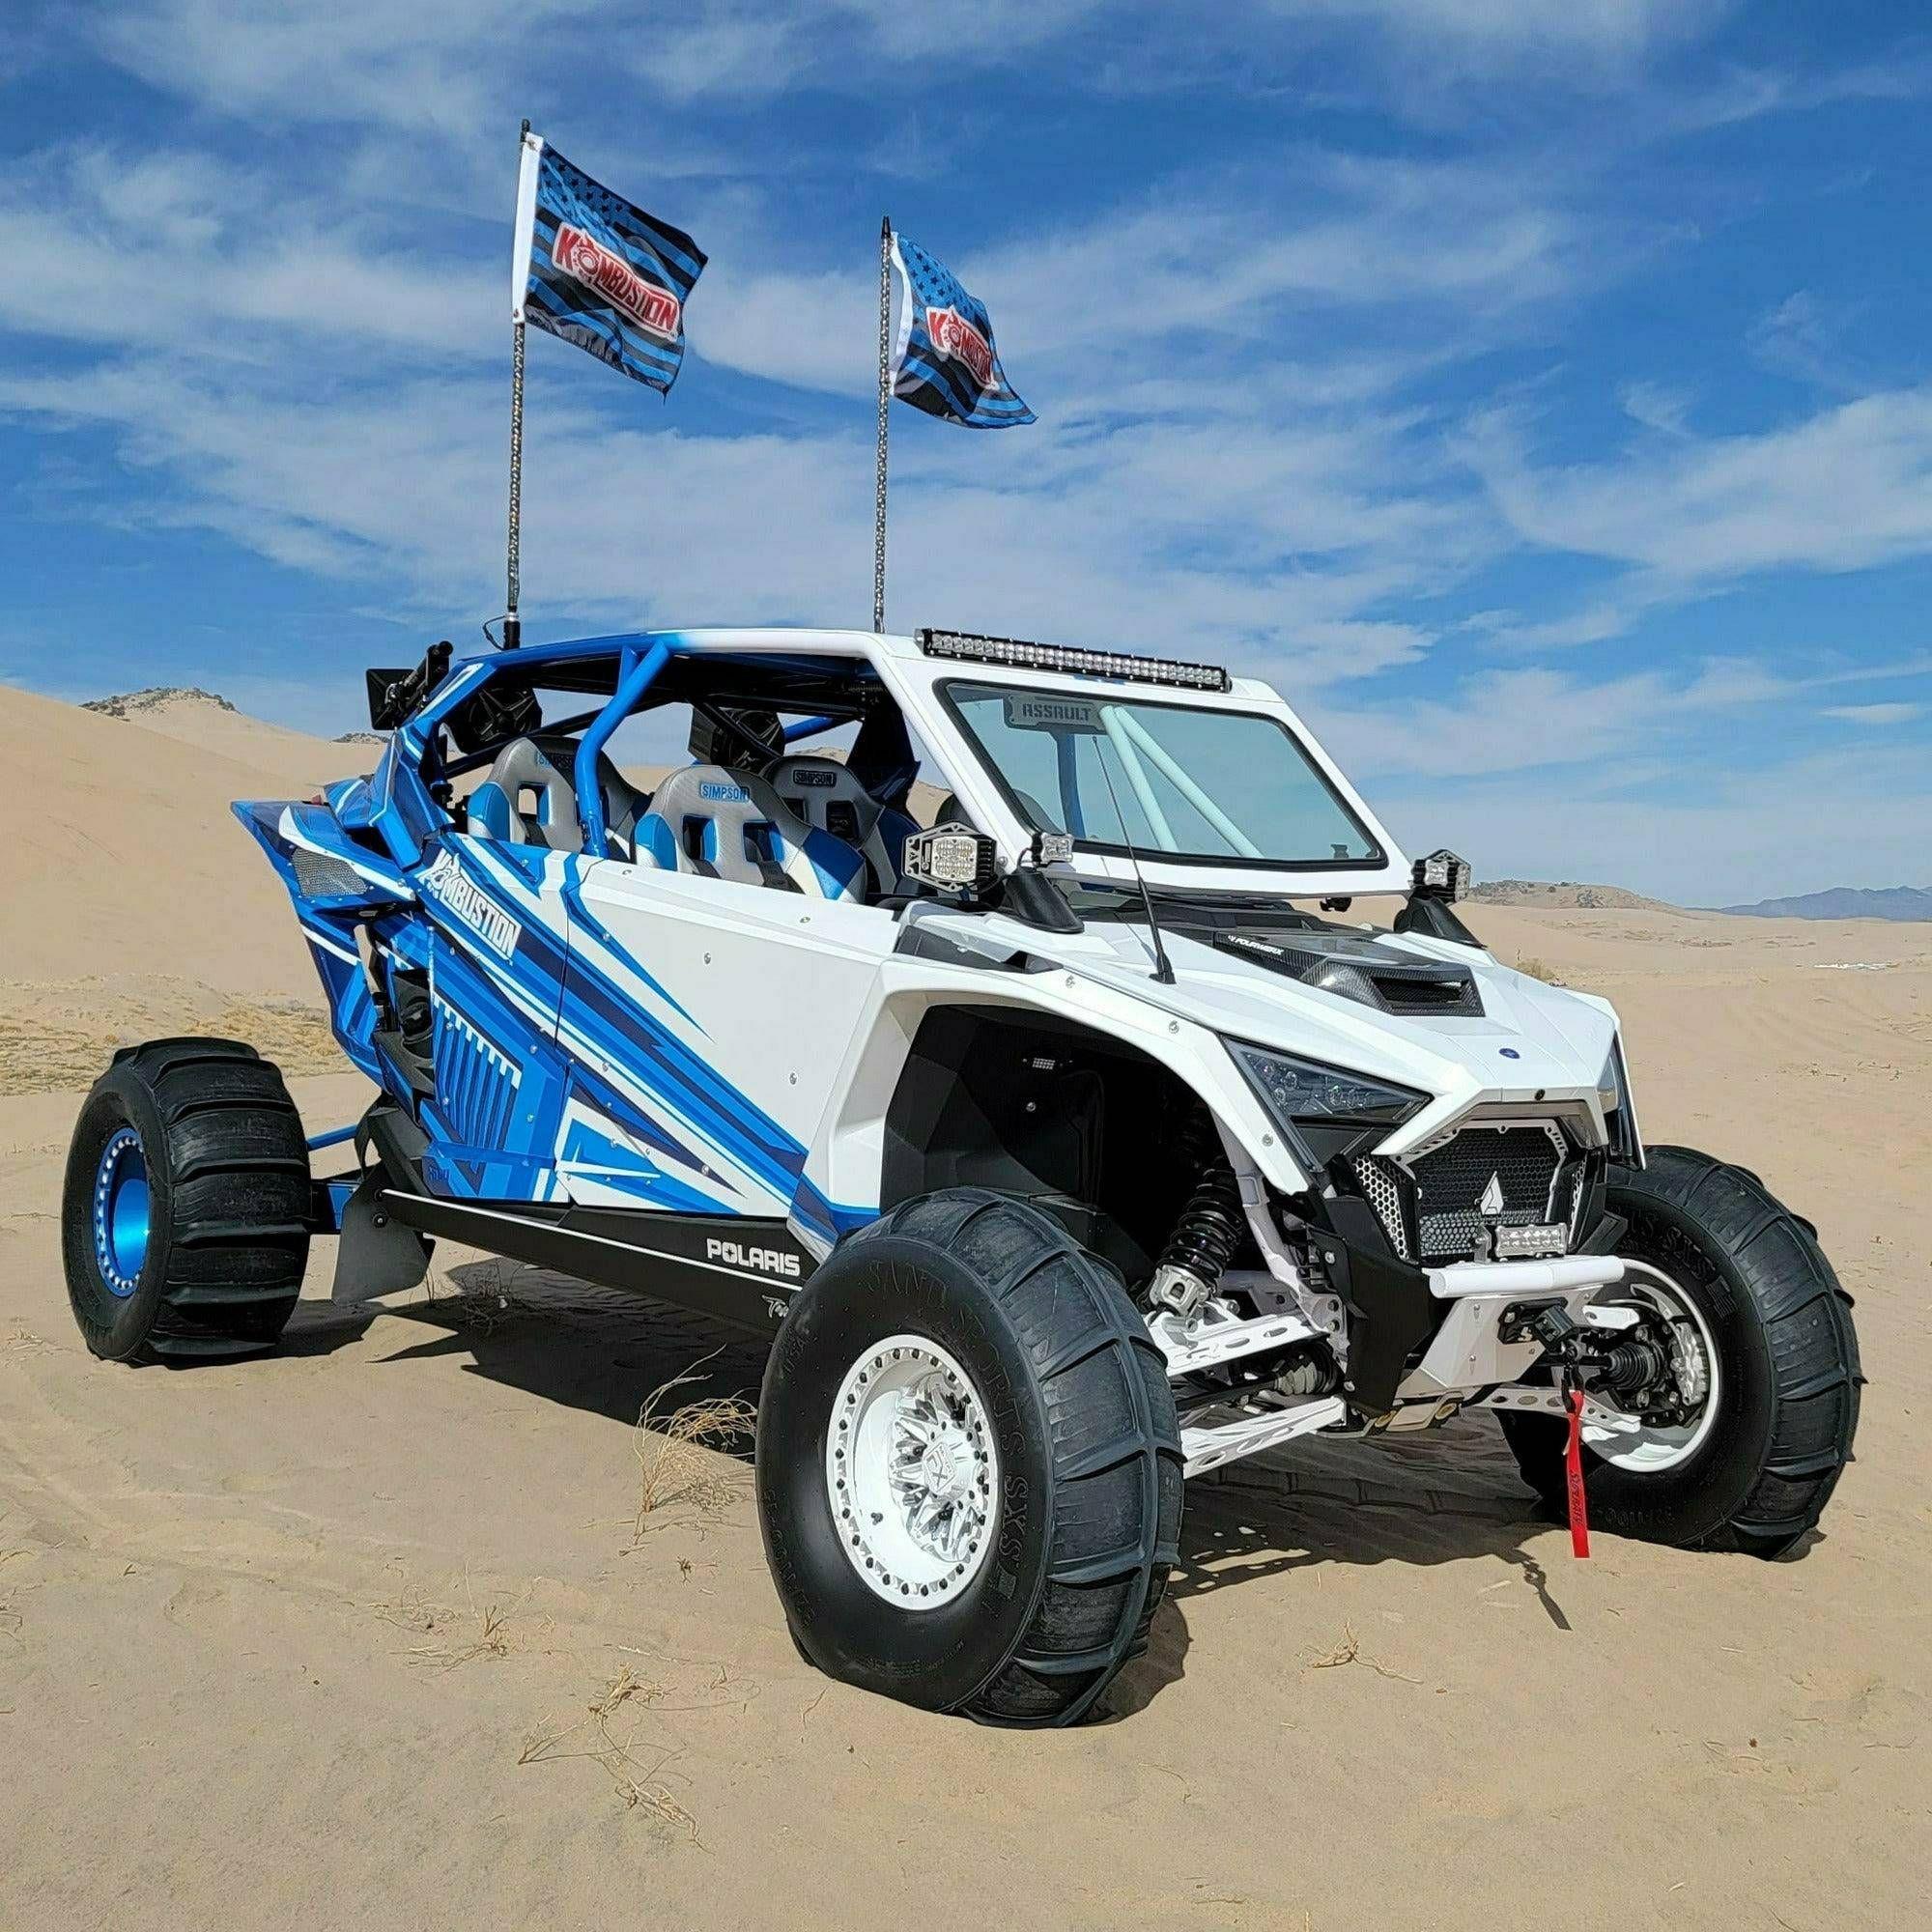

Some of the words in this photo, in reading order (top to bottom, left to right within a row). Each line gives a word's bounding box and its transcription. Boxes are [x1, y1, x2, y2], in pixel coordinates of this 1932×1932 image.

[555, 227, 677, 331] KOMBUSTION
[1022, 703, 1091, 722] ASSAULT
[702, 784, 747, 800] SIMPSON
[413, 848, 522, 960] KOMBUSTION
[706, 1237, 801, 1276] POLARIS
[999, 1474, 1029, 1561] SXS
